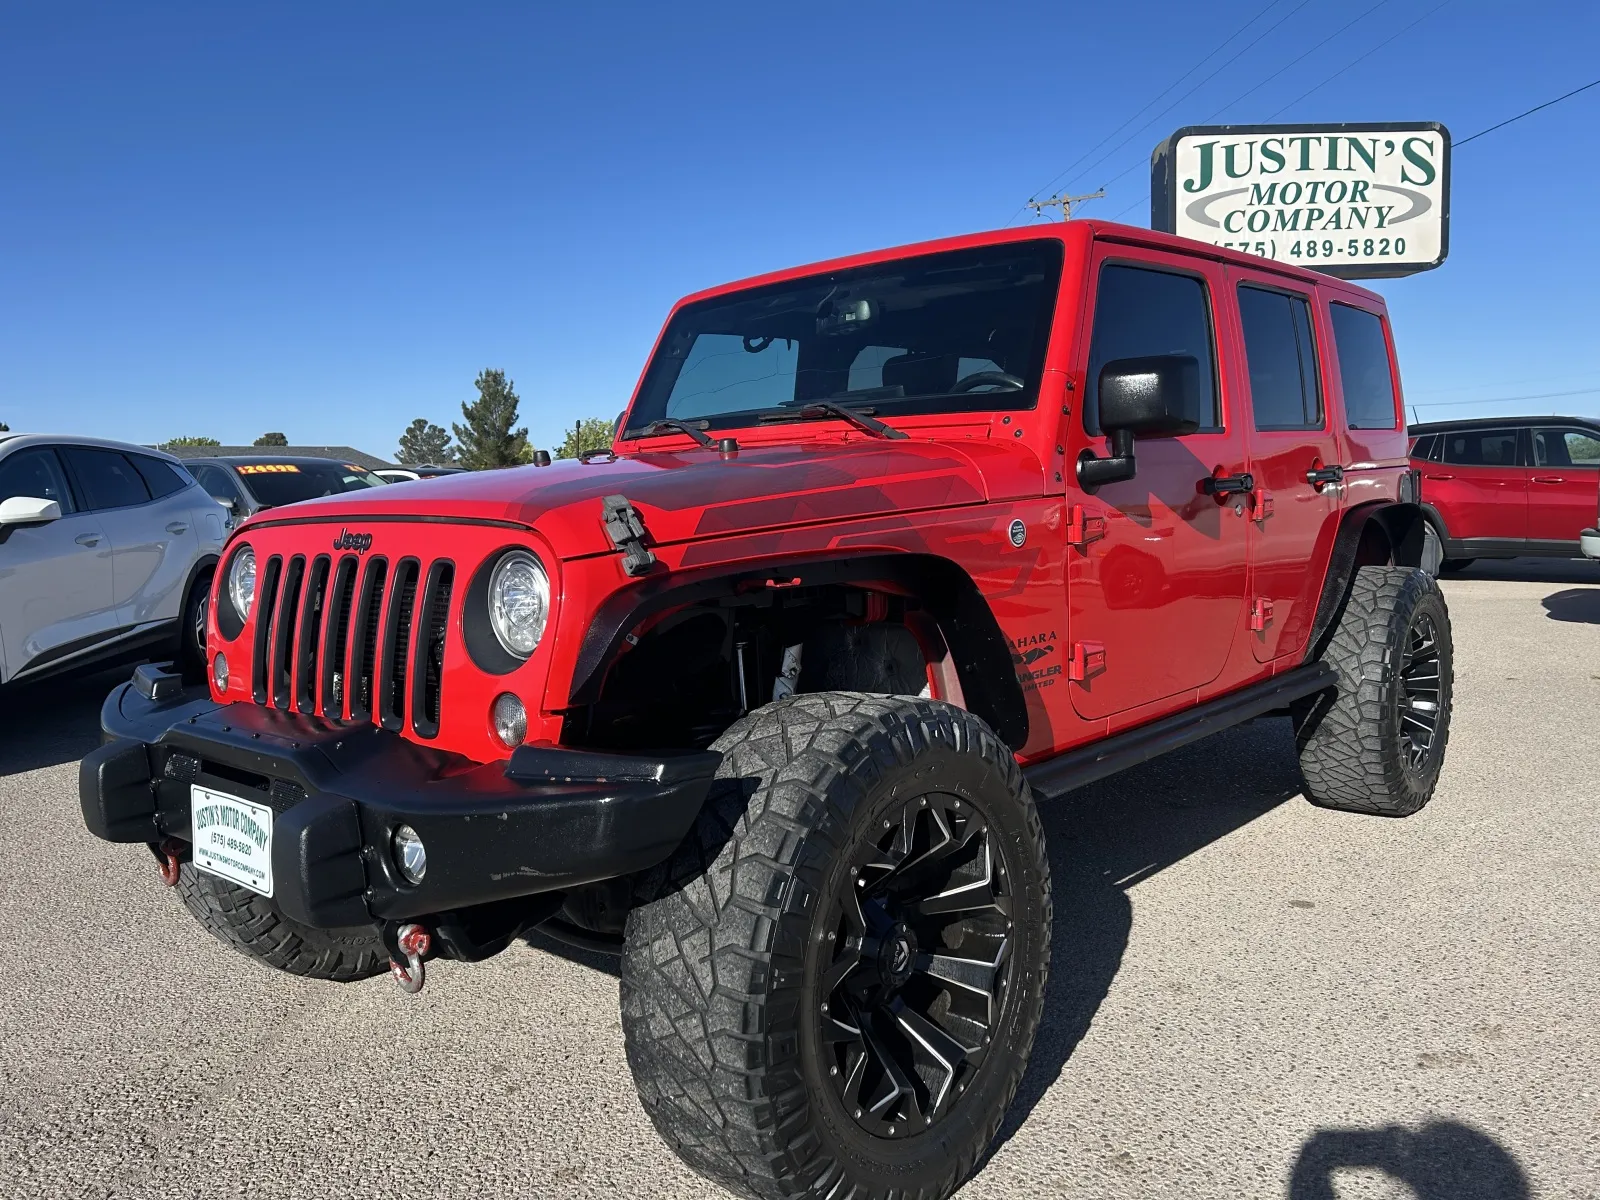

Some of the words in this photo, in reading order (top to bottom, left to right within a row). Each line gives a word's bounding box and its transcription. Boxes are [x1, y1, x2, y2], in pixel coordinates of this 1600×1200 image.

[1183, 136, 1436, 193] JUSTIN'S
[1247, 180, 1370, 206] MOTOR
[1223, 205, 1394, 233] COMPANY
[1290, 238, 1406, 259] 489-5820
[333, 528, 372, 555] Jeep
[196, 805, 220, 830] JUSTIN'S
[220, 805, 240, 831] MOTOR
[241, 812, 268, 852] COMPANY
[211, 832, 226, 848] (575)
[227, 837, 252, 856] 489-5820
[198, 847, 266, 880] WWW.JUSTINSMOTORCOMPANY.COM
